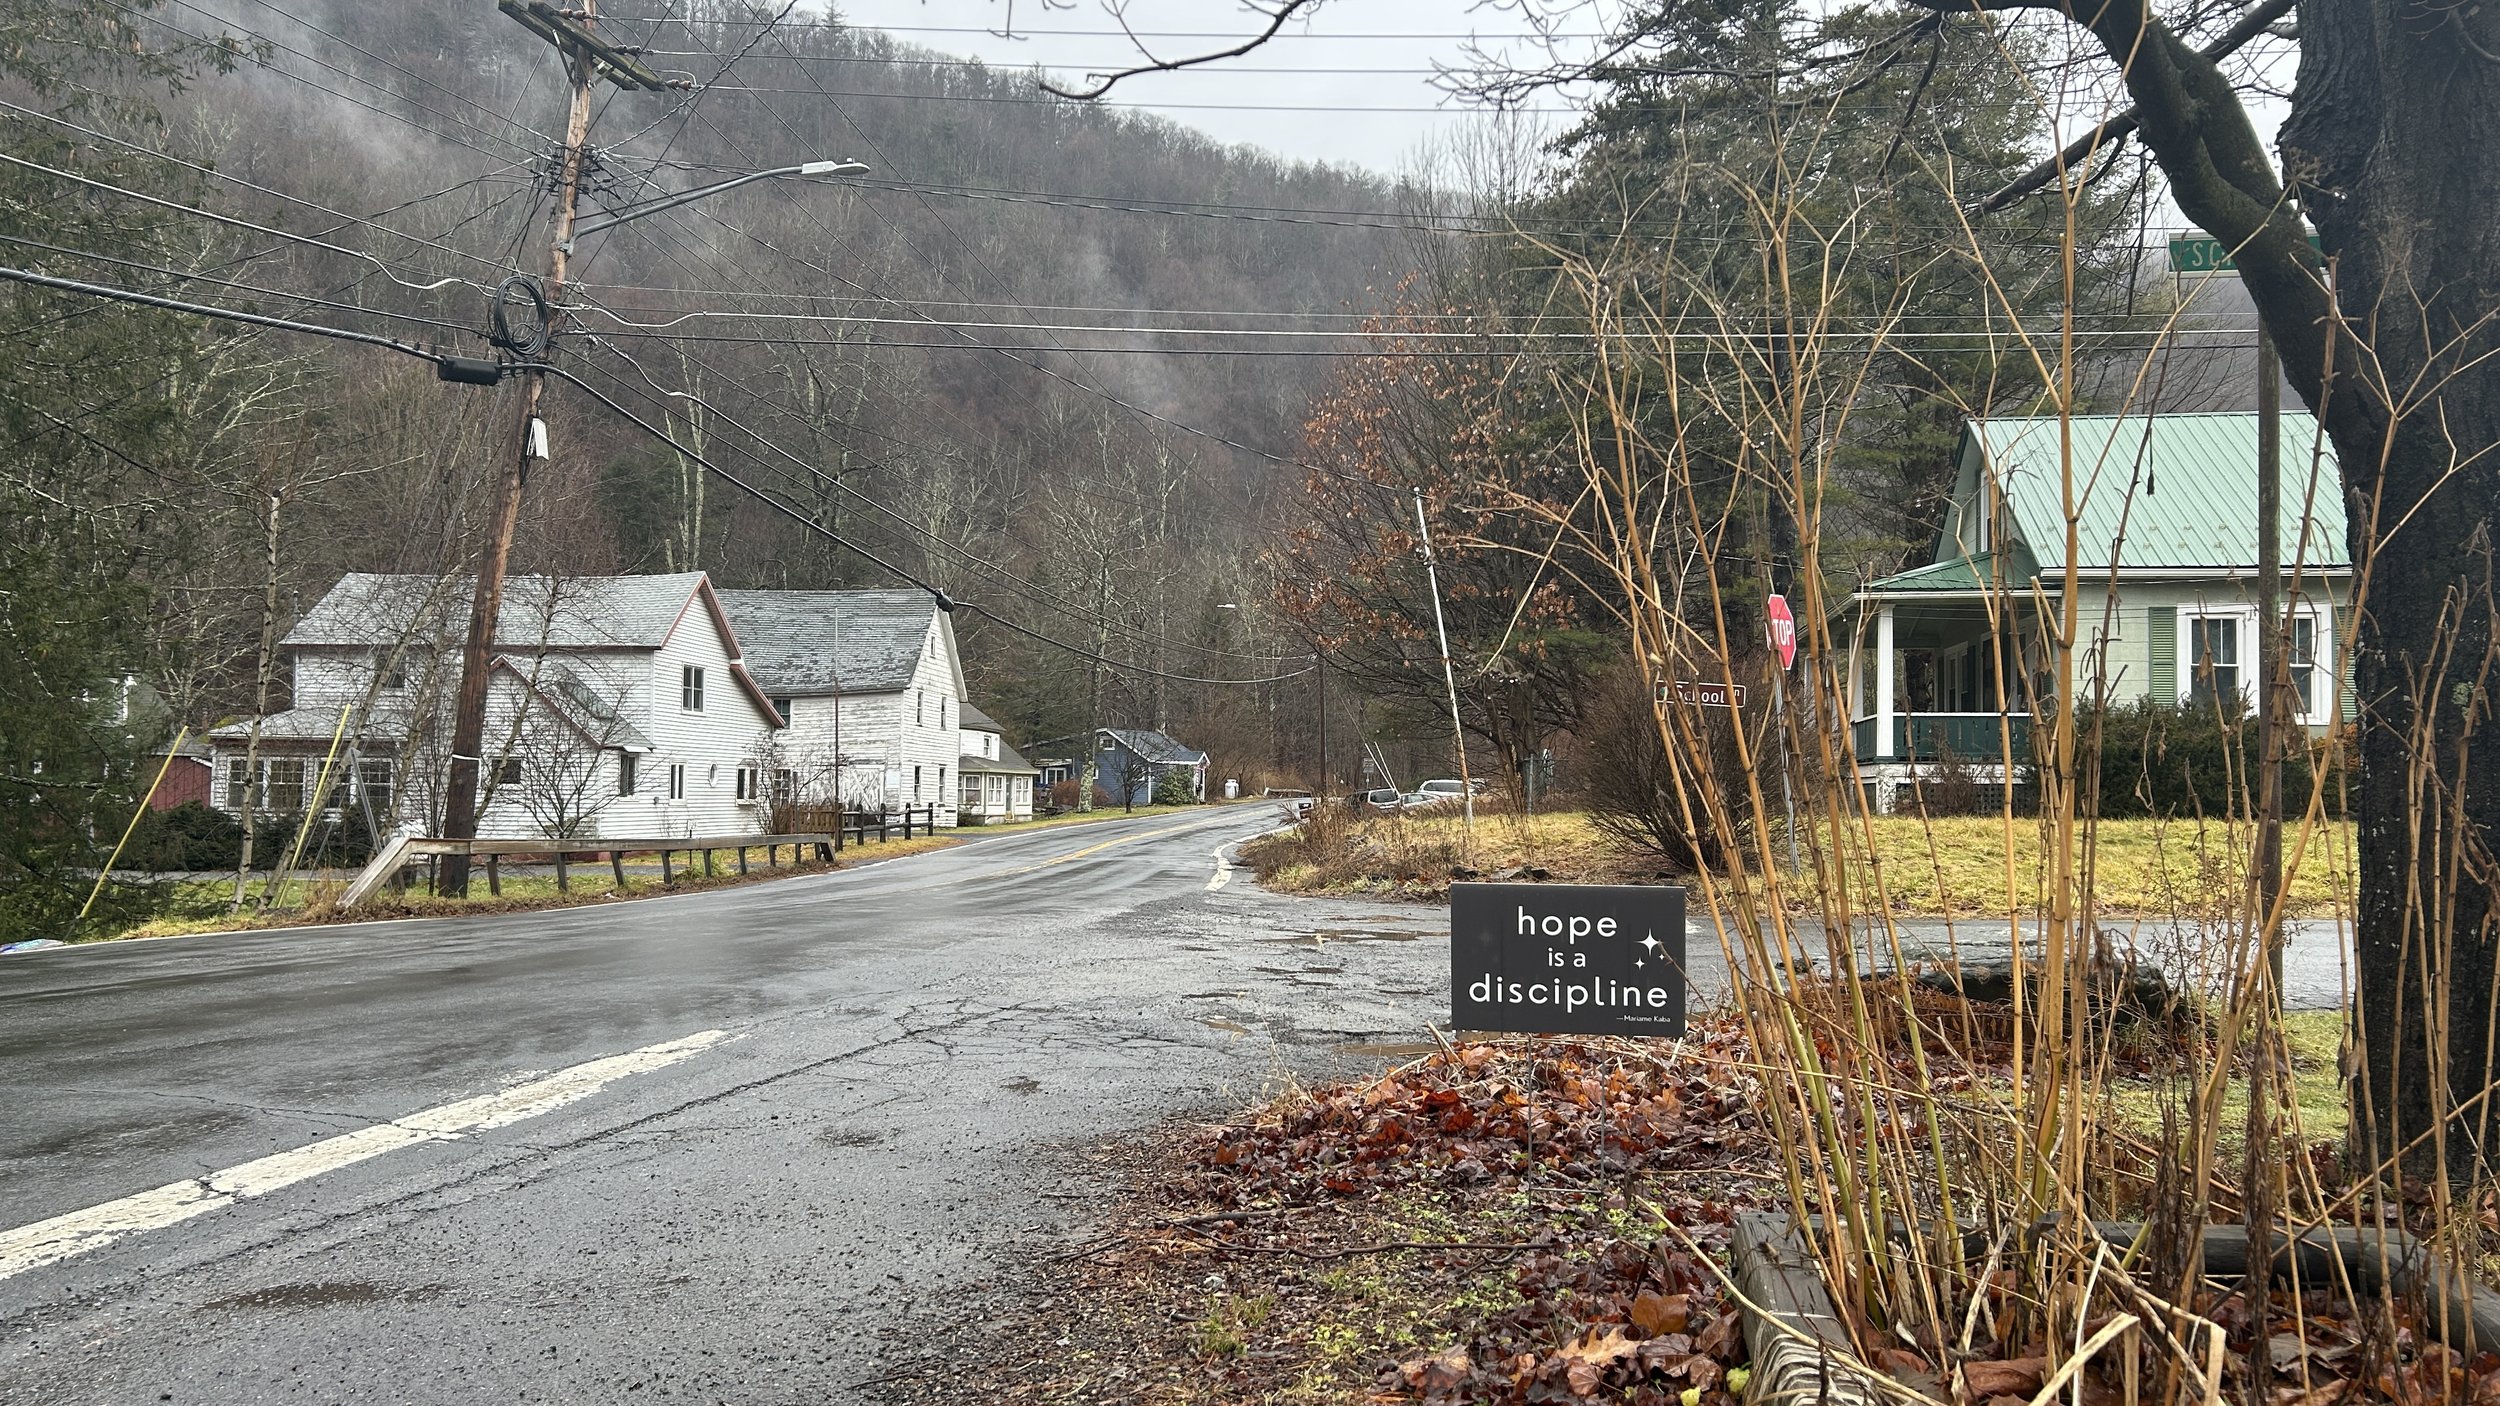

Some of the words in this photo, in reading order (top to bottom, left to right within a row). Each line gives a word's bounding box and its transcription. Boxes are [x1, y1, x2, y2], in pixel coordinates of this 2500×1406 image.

[2191, 241, 2232, 267] SC
[1768, 618, 1793, 646] TOP
[1518, 905, 1618, 945] hope
[1547, 947, 1565, 967] is
[1573, 952, 1586, 968] a
[1468, 972, 1668, 1014] discipline
[1653, 1015, 1671, 1023] Kaba
